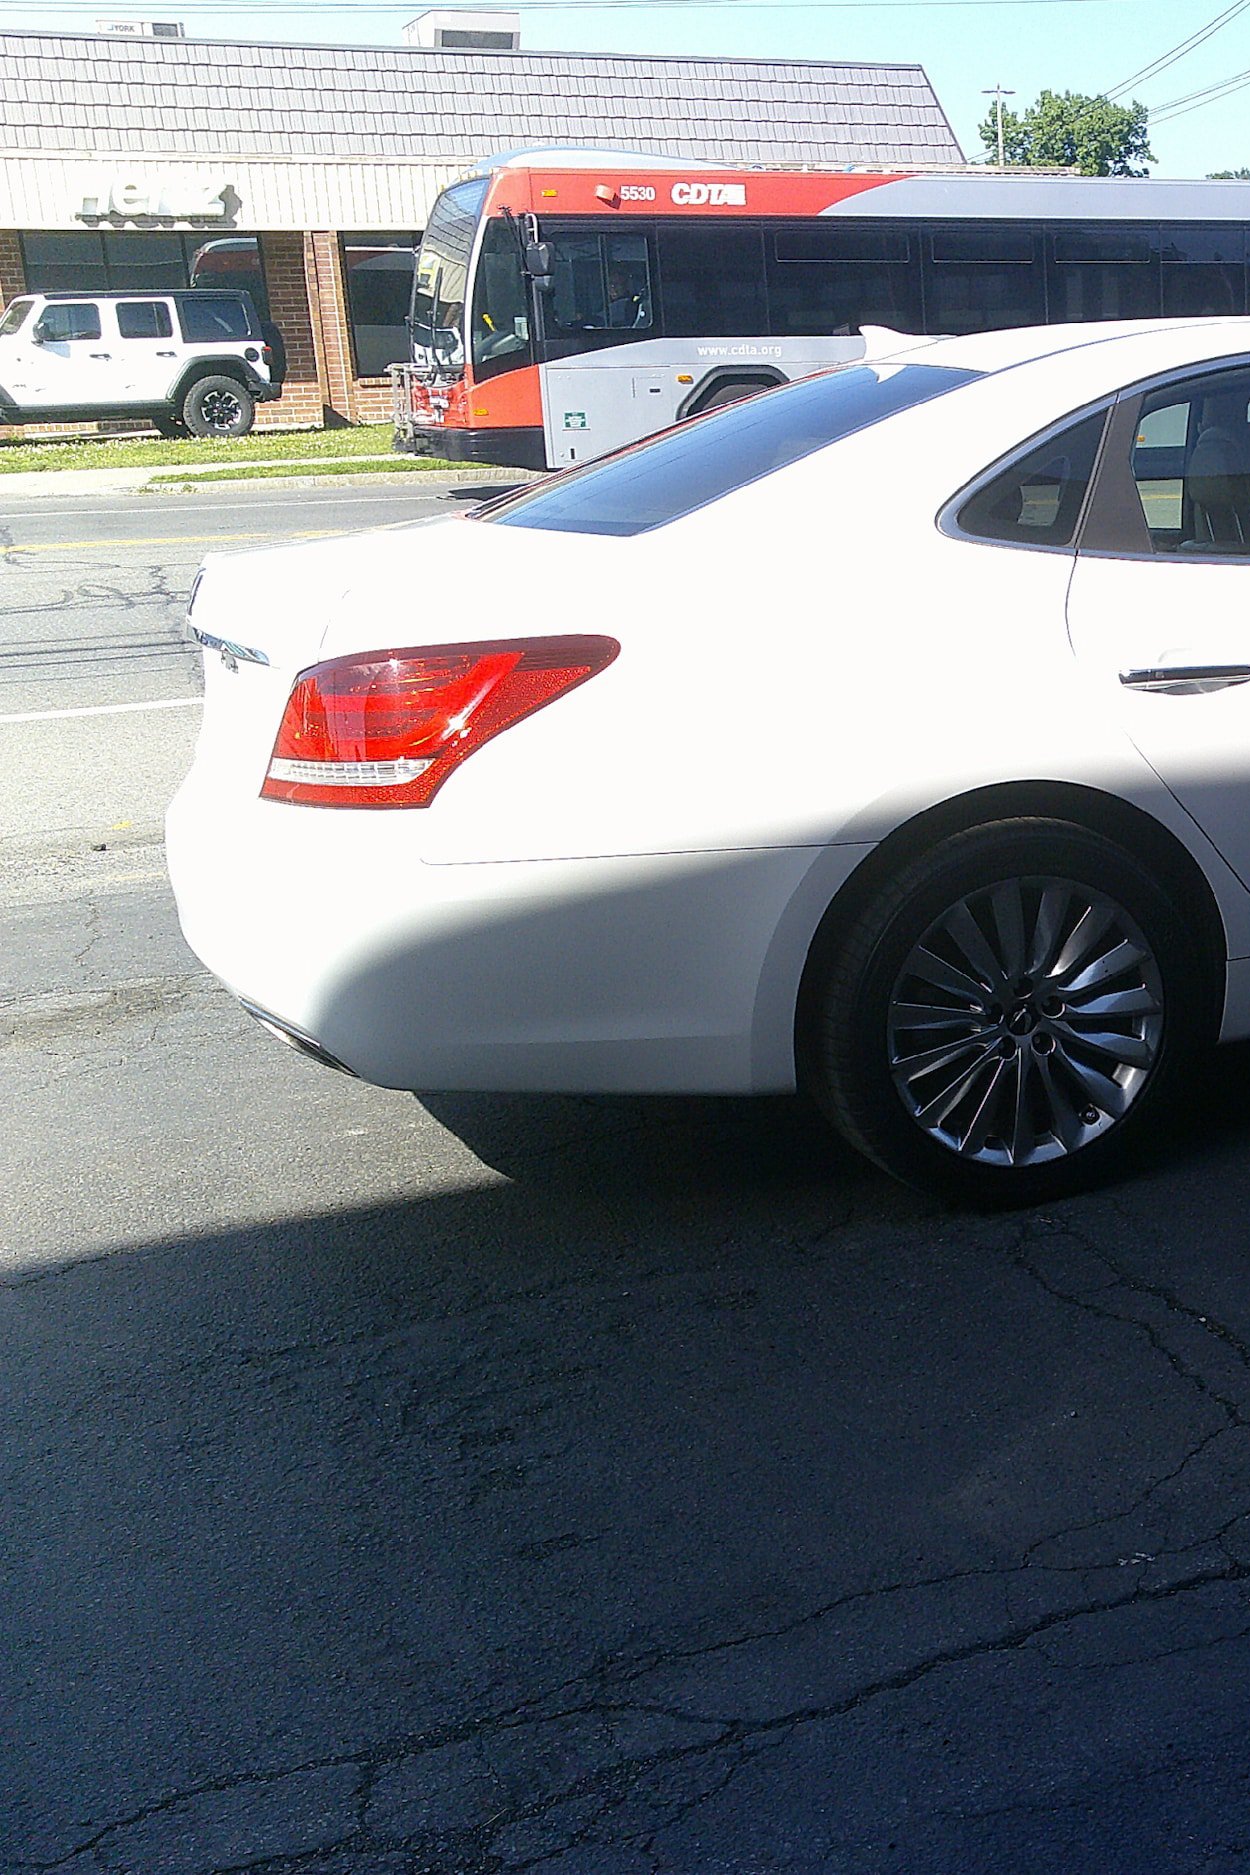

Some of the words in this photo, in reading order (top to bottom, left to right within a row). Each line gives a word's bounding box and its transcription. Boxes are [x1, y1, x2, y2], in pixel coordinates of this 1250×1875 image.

[114, 24, 135, 32] YORK
[620, 186, 656, 201] 5530
[671, 182, 746, 206] CDTA
[697, 345, 782, 357] www.cdta.org
